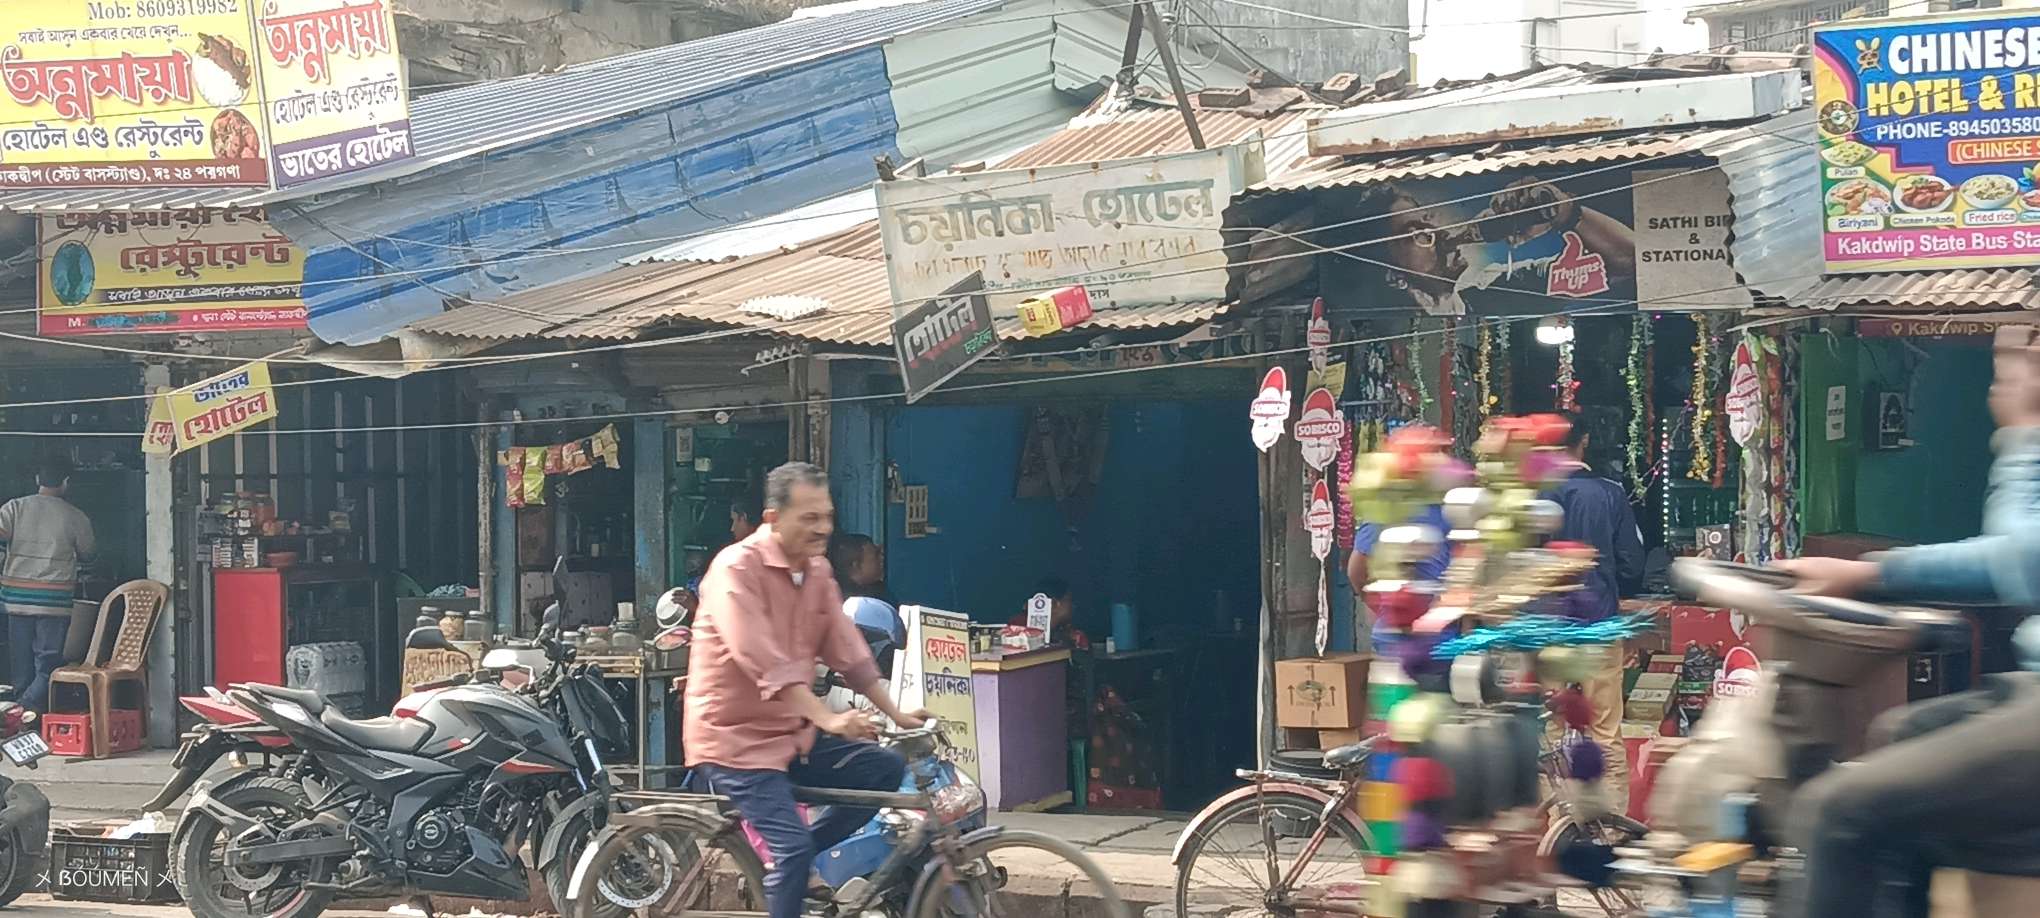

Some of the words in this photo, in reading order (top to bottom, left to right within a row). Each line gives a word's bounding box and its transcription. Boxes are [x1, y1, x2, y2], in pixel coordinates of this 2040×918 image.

[88, 2, 132, 20] Mob:
[136, 0, 238, 17] 8609319982
[2, 45, 193, 122] অন্নমায়া
[1866, 78, 1970, 117] HOTEL
[1979, 75, 2006, 111] &
[3, 121, 67, 150] হোটেল
[115, 116, 205, 159] রেস্টুরেন্ট
[278, 142, 342, 178] ভাতের
[346, 124, 410, 167] হোটেল
[173, 165, 192, 180] ২৪
[895, 192, 1056, 252] চয়নিকা
[1083, 172, 1214, 229] হোটেল
[1648, 216, 1699, 229] SATHI
[1968, 212, 1994, 222] Fried
[1688, 232, 1700, 245] &
[1838, 233, 1915, 257] Kakdwip
[1919, 231, 1967, 252] State
[1971, 231, 2008, 250] Bus
[120, 232, 293, 279] রেস্টুরেন্ট
[1641, 248, 1726, 262] STATIONA
[183, 391, 269, 441] হোটেল
[926, 634, 967, 664] হোটেল
